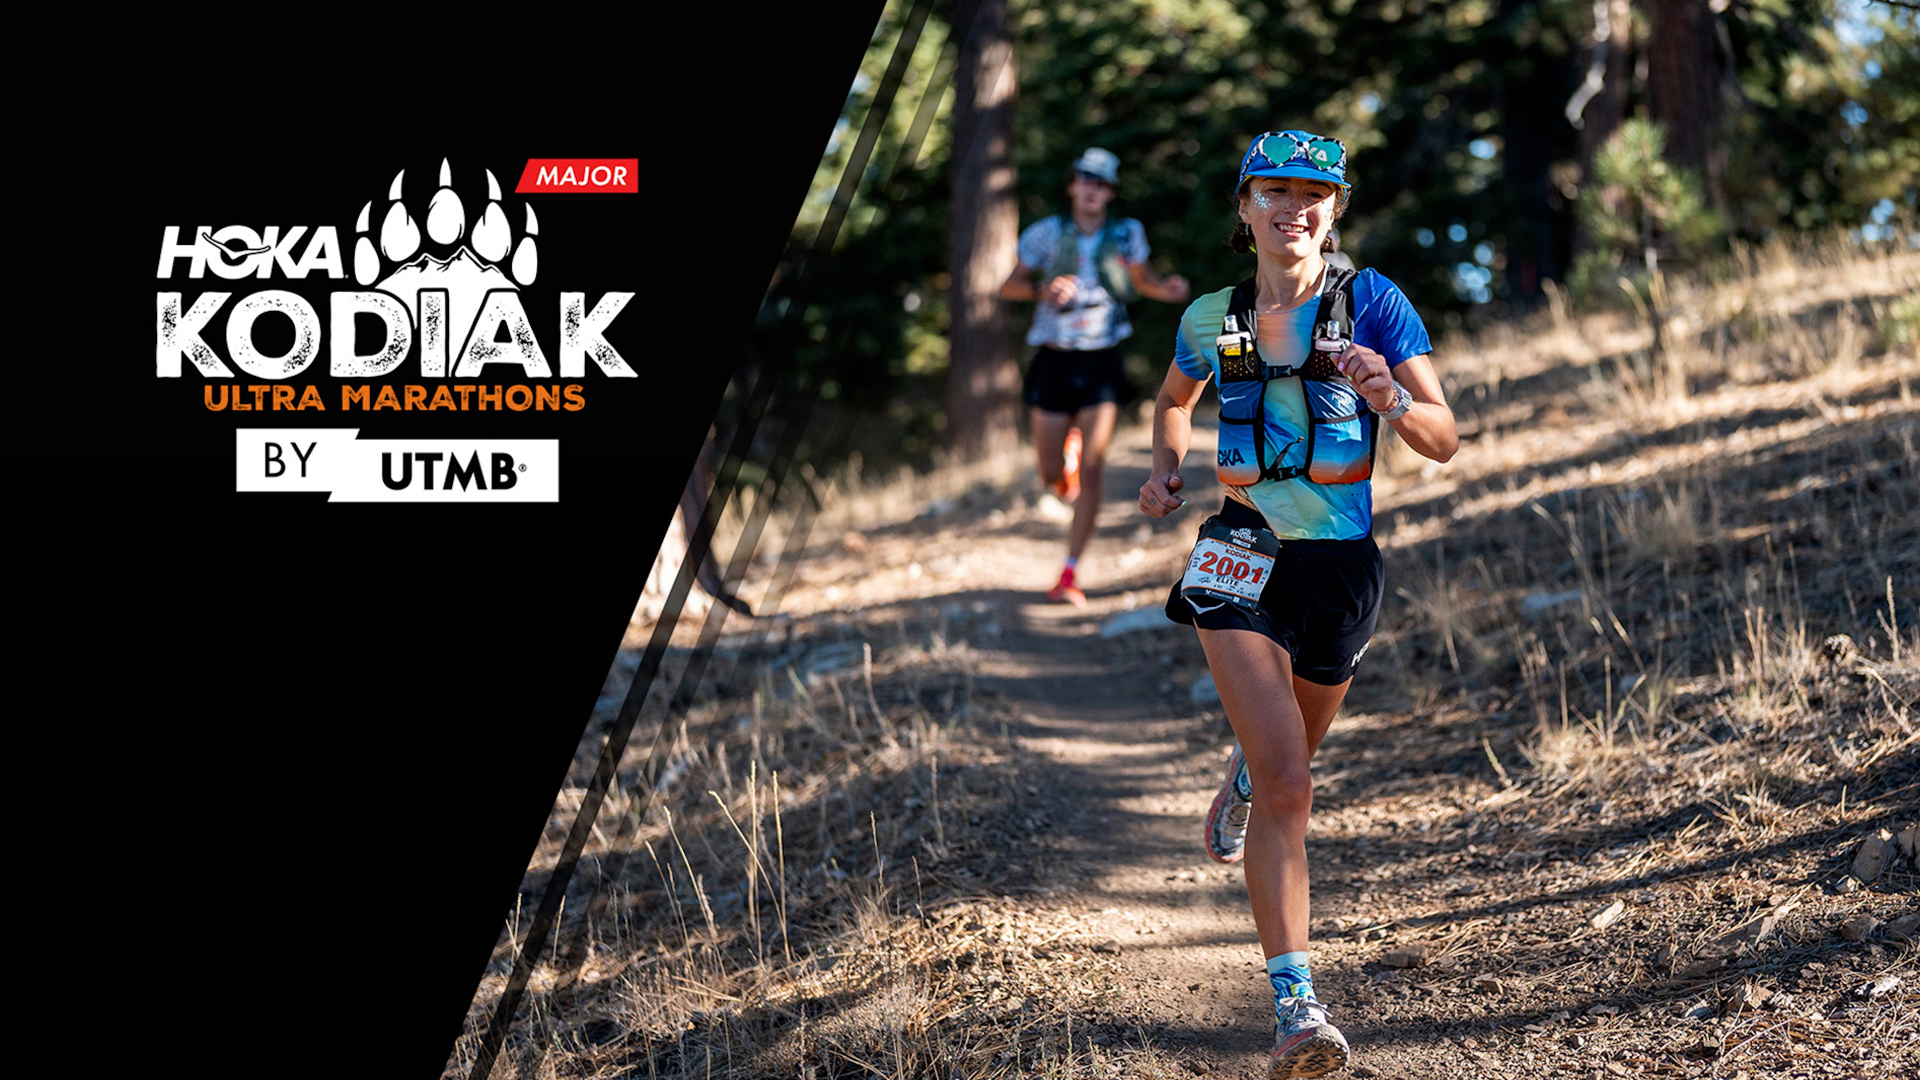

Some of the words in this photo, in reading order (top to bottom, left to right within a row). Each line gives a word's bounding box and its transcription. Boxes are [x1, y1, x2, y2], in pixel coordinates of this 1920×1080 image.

[1225, 548, 1252, 561] KODIAK
[1198, 551, 1264, 584] 2001
[1216, 576, 1240, 587] ELITE
